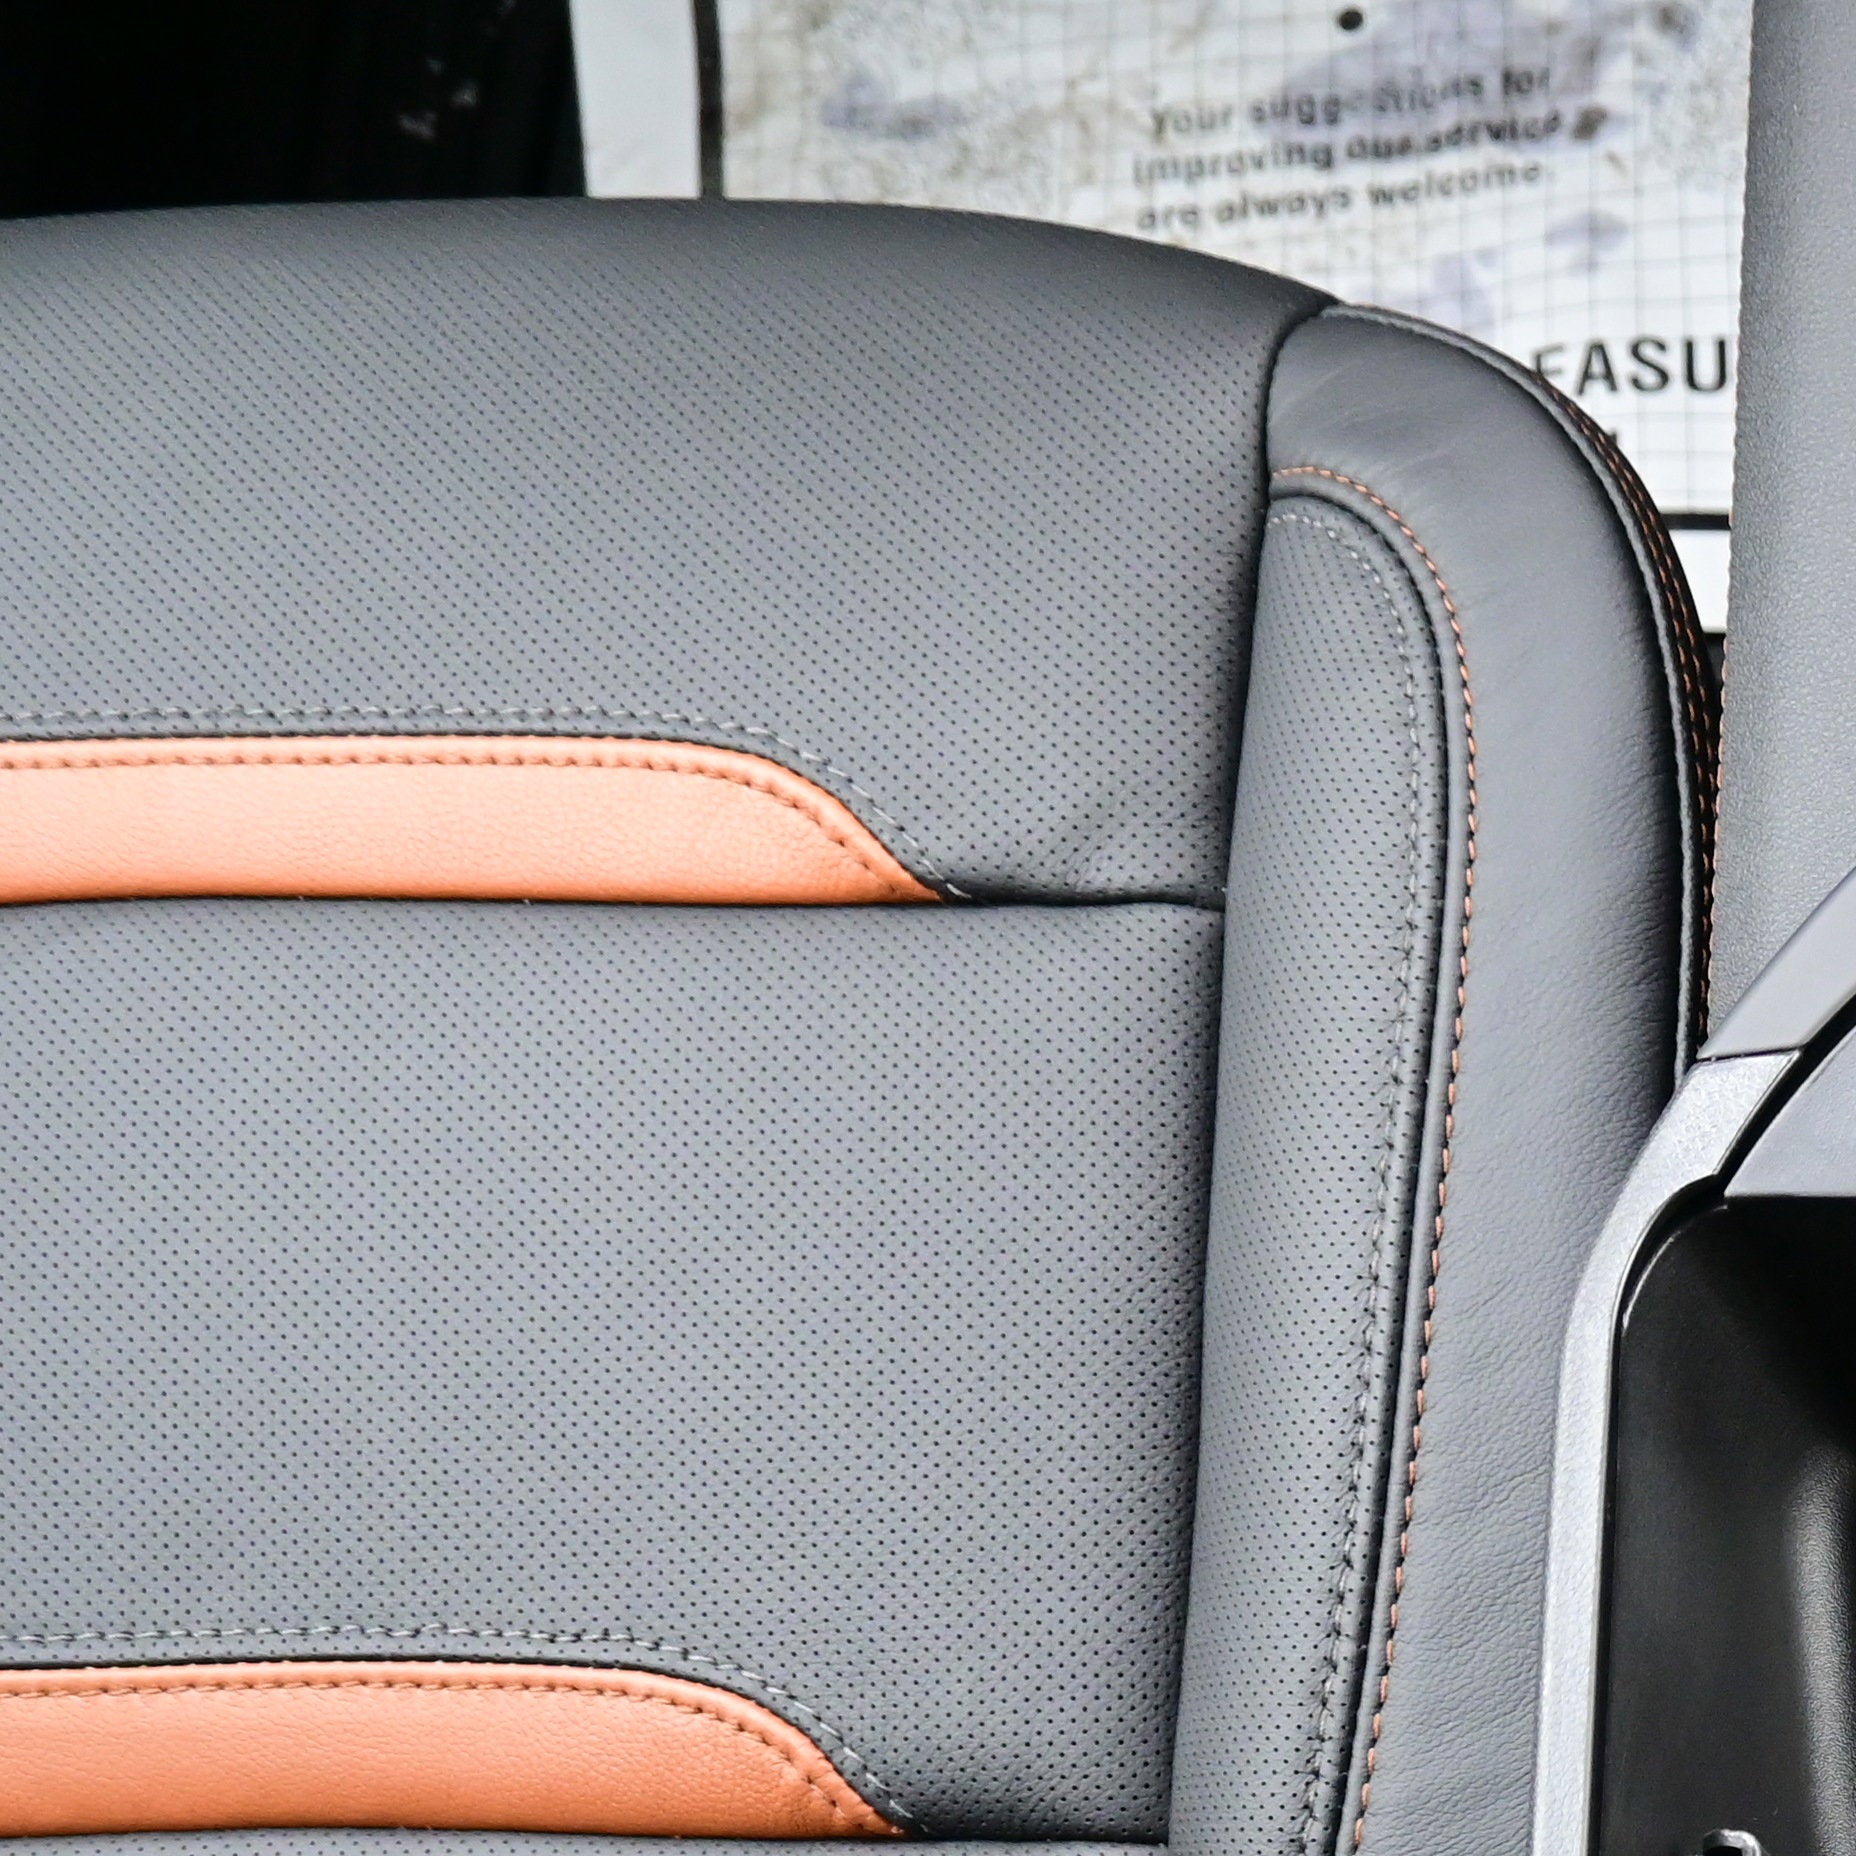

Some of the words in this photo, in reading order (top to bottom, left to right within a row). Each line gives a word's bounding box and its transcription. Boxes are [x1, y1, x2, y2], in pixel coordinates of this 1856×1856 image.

[1133, 136, 1335, 187] improving
[1136, 203, 1200, 230] are
[1215, 184, 1351, 220] always
